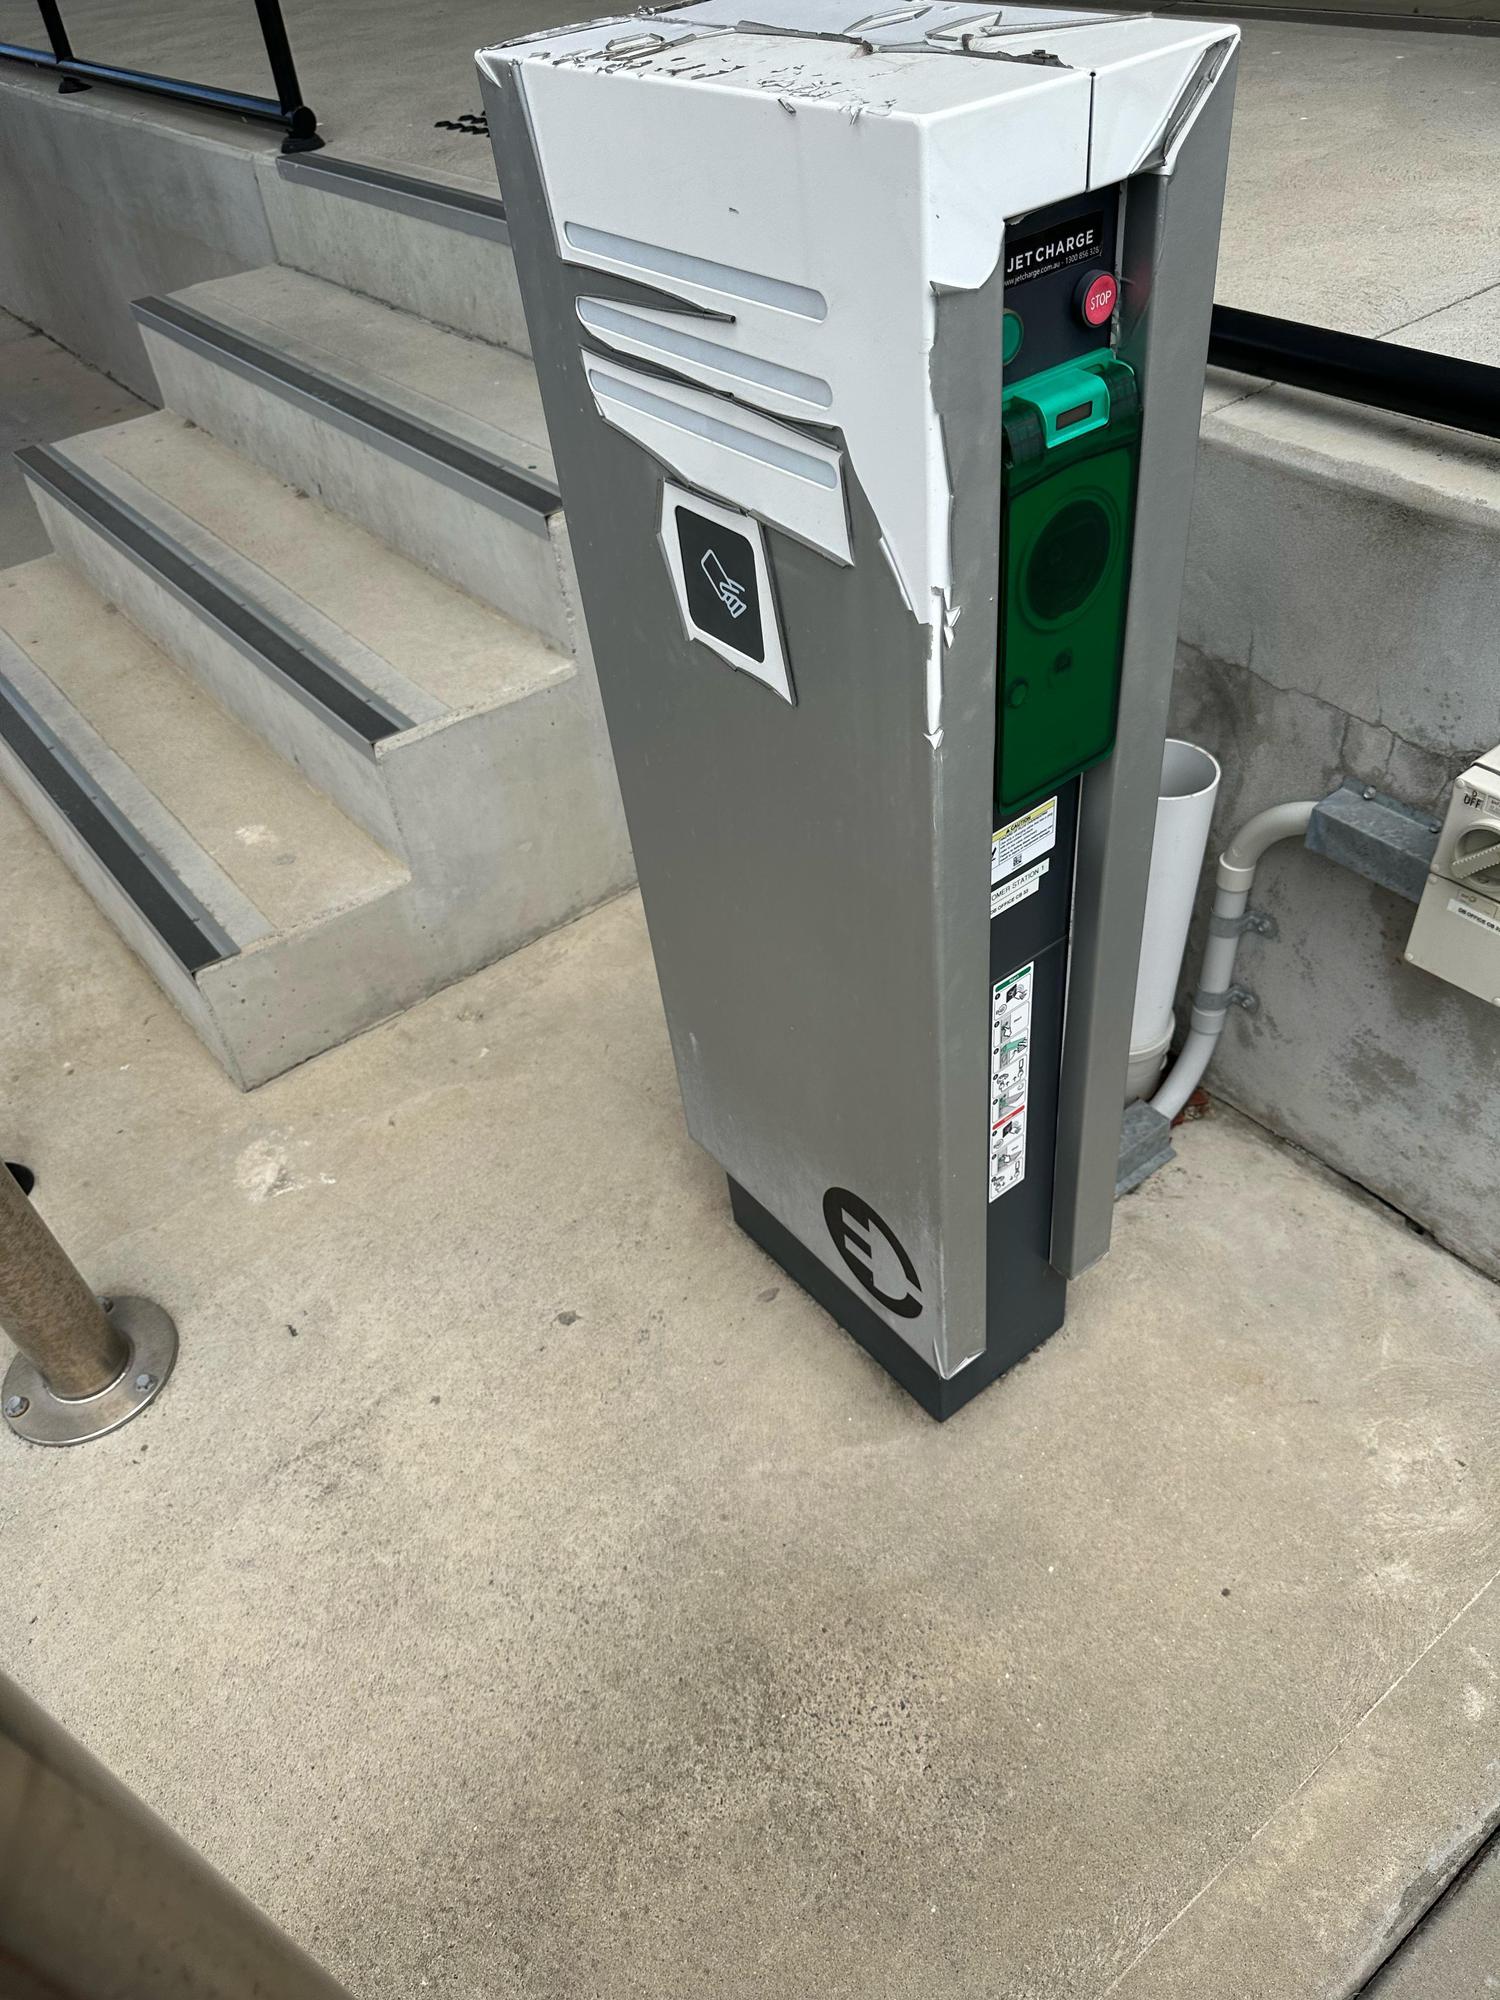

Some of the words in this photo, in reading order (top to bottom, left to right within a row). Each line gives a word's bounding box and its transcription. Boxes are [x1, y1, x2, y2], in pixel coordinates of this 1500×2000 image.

[1007, 251, 1033, 273] JET
[1035, 229, 1094, 262] CHARGE
[1090, 290, 1112, 311] STOP
[1463, 794, 1485, 809] OFF
[1010, 816, 1032, 831] CAUTION
[1012, 867, 1040, 889] STATION
